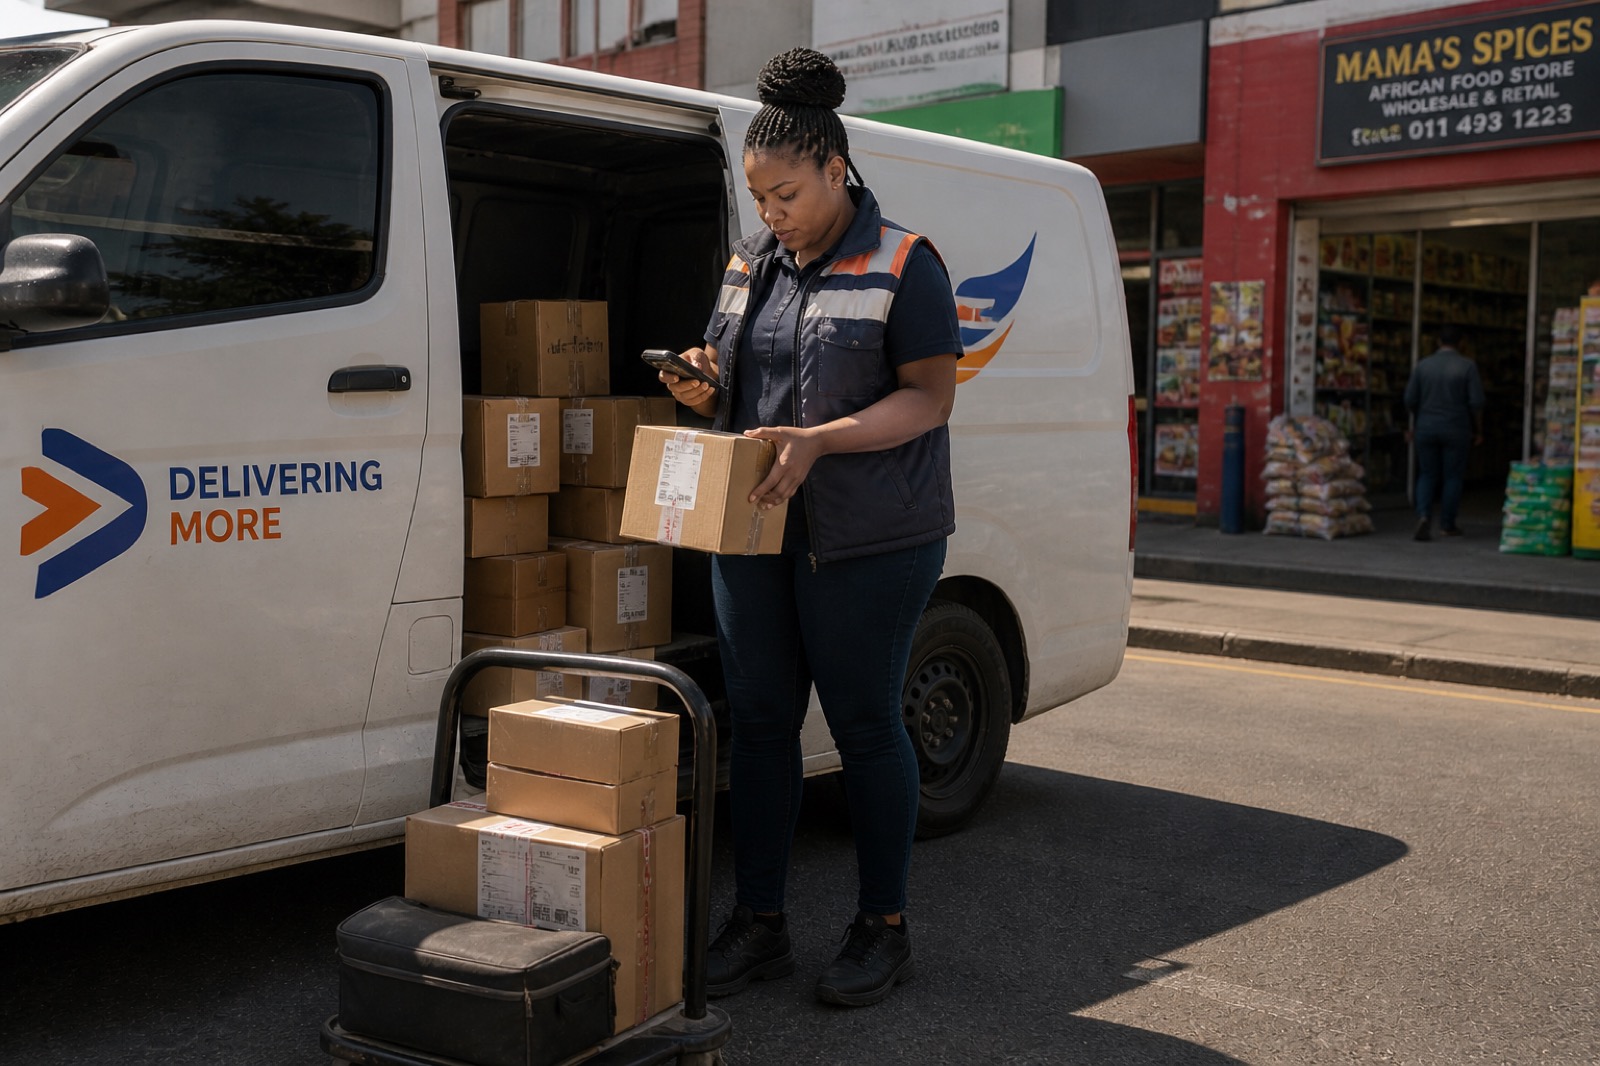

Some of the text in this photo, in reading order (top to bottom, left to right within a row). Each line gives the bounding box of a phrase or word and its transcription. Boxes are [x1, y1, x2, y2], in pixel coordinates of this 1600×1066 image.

[1336, 17, 1594, 83] MAMA'S SPICES
[1369, 61, 1574, 101] AFRICAN FOOD STORE
[1382, 83, 1559, 117] WHOLESALE & RETAIL
[1409, 118, 1448, 140] 011
[1456, 112, 1502, 135] 493
[1512, 105, 1573, 129] 1223
[170, 460, 382, 500] DELIVERING
[170, 508, 281, 546] MORE
